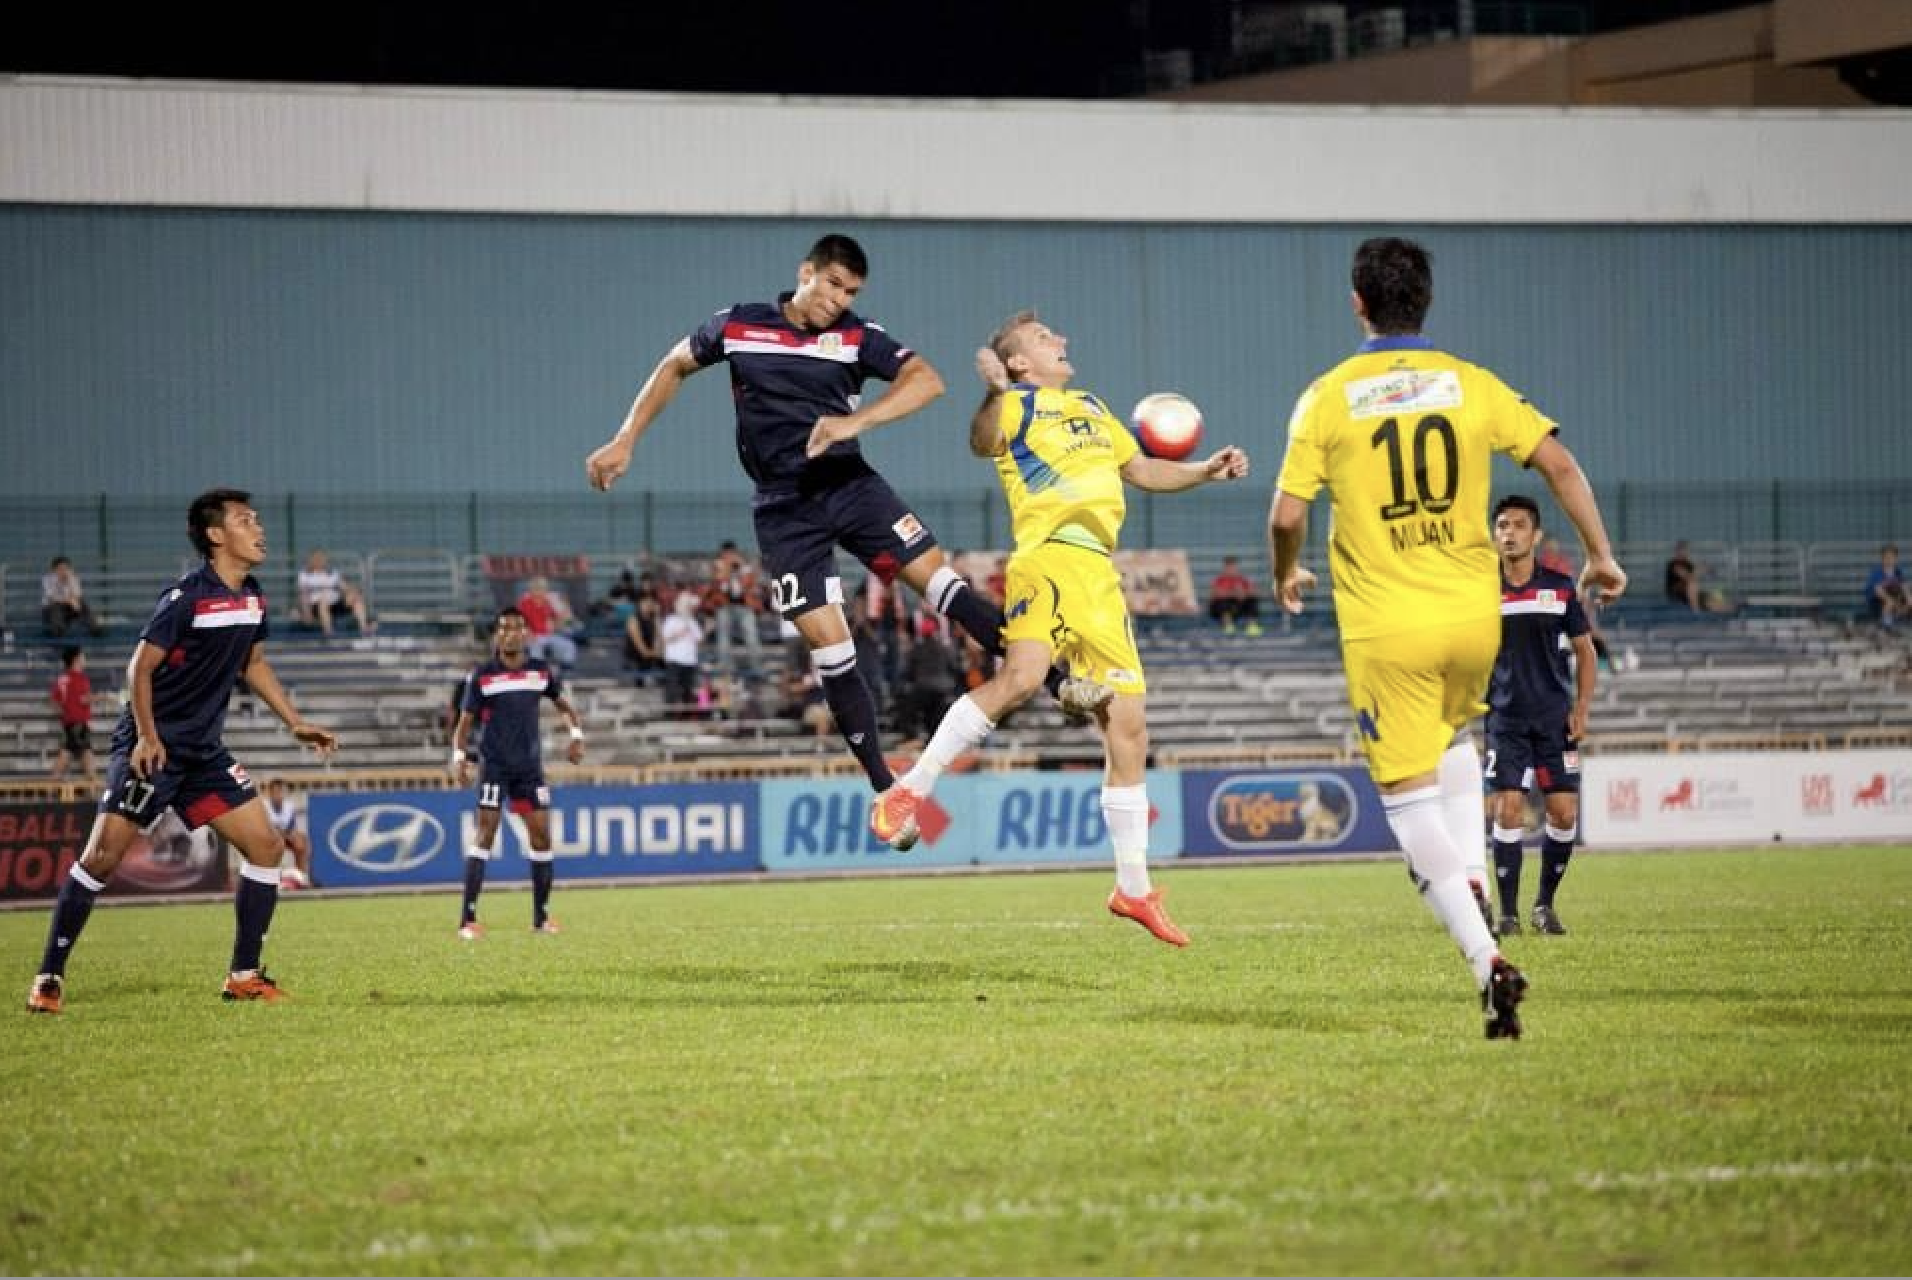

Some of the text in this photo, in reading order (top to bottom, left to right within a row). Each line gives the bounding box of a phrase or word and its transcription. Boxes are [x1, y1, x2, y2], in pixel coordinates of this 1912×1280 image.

[1370, 414, 1459, 521] 10
[118, 780, 155, 814] 17
[480, 783, 500, 806] 11
[1222, 792, 1299, 838] Tiger
[0, 813, 82, 842] BALL
[784, 793, 891, 856] RH
[996, 786, 1107, 851] RHB
